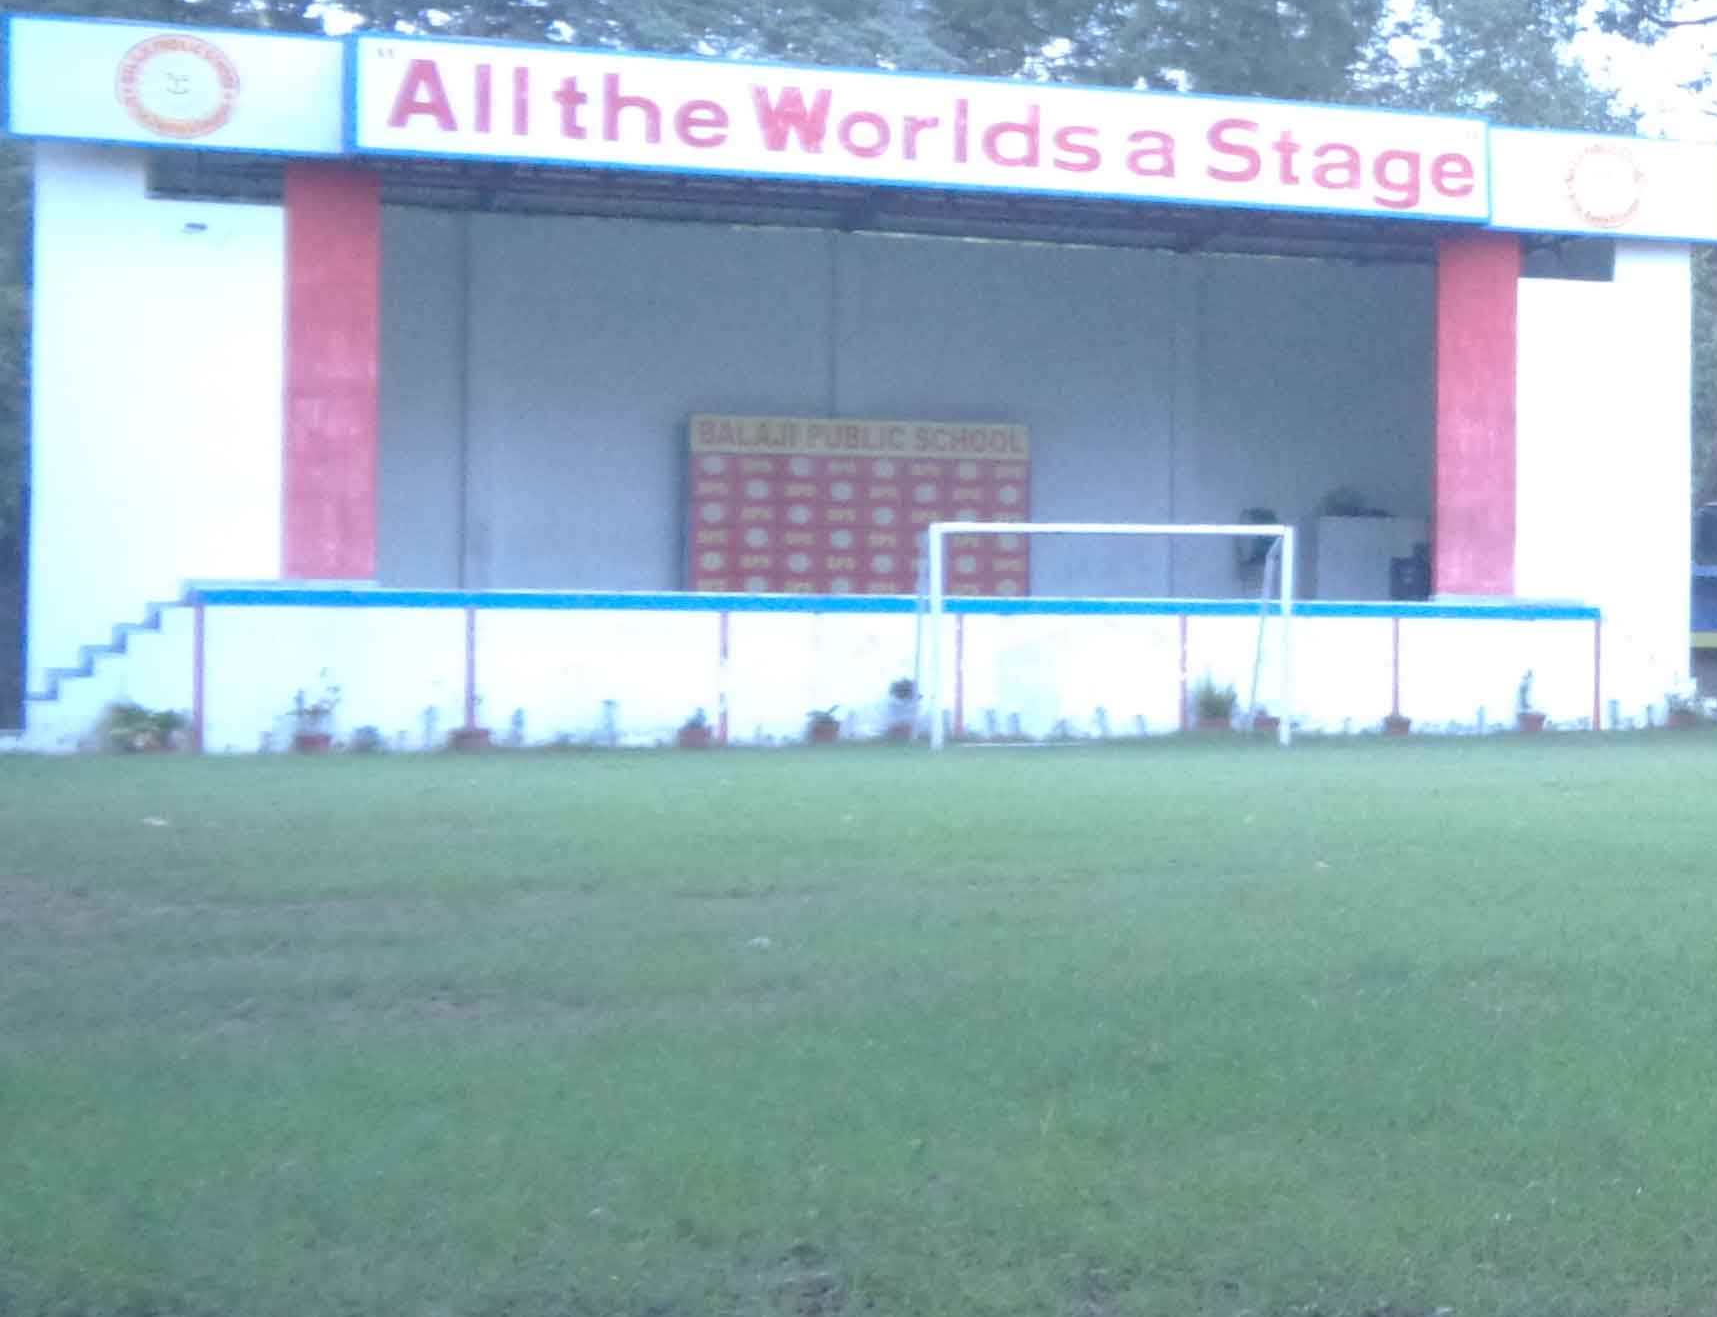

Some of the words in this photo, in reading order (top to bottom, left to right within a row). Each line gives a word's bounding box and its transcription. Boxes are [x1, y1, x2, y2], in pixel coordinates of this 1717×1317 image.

[751, 84, 1102, 173] Worlds
[1125, 129, 1176, 178] a
[1205, 117, 1475, 210] Stage
[698, 419, 798, 448] BALAJI
[806, 424, 904, 451] PUBLIC
[915, 427, 1025, 453] SCHOOL
